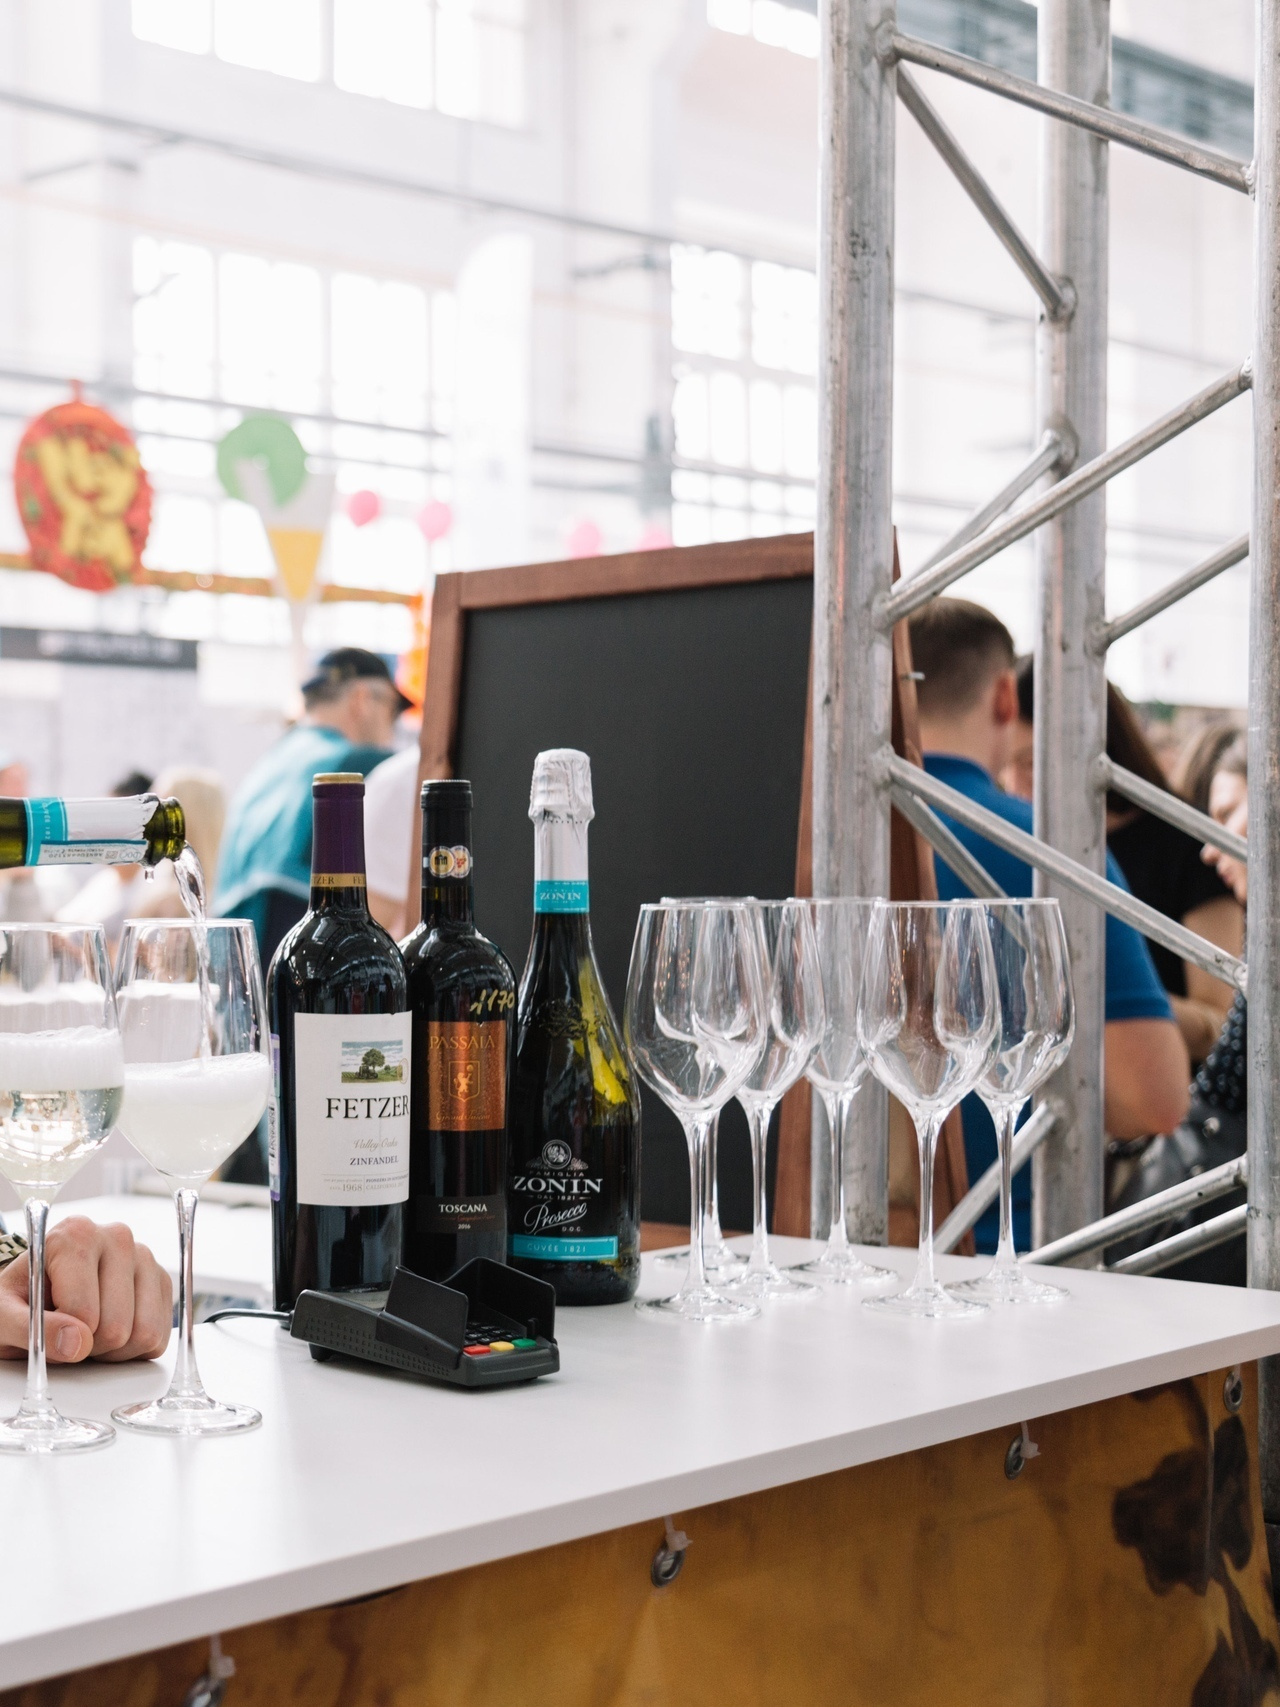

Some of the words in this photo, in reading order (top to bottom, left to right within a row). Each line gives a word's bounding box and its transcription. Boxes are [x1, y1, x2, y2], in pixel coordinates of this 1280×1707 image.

[539, 891, 582, 901] ZONIN
[325, 1095, 410, 1119] FETZER
[353, 1138, 380, 1153] Valley
[349, 1155, 400, 1166] ZINFANDEL
[342, 1183, 363, 1192] 1968
[513, 1175, 604, 1194] ZONIN
[438, 1203, 488, 1214] TOSCANA
[524, 1200, 588, 1235] Prosecco
[527, 1242, 559, 1252] CUVÉE
[564, 1243, 587, 1253] 1821
